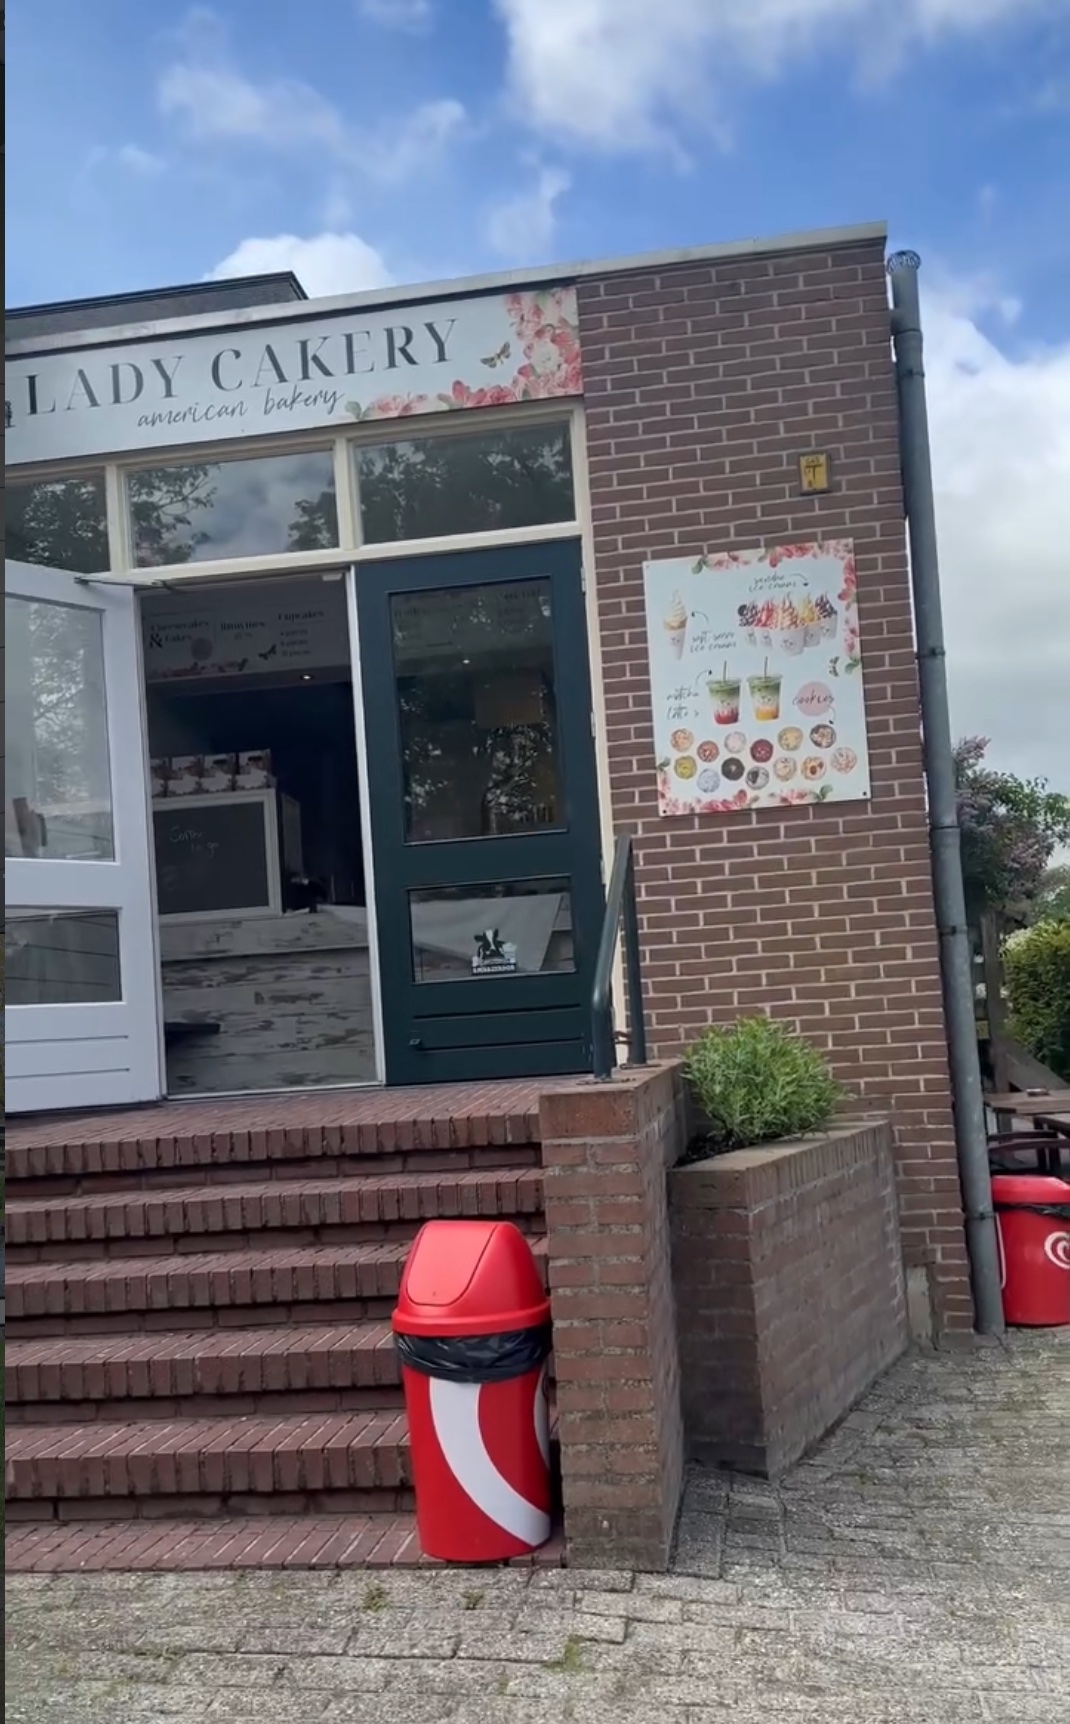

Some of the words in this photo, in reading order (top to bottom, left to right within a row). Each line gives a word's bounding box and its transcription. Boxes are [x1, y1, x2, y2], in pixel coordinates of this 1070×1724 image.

[25, 354, 184, 415] LADY
[211, 317, 458, 391] CAKERY
[137, 400, 248, 428] american
[264, 383, 345, 416] bakery
[792, 689, 836, 706] cookies
